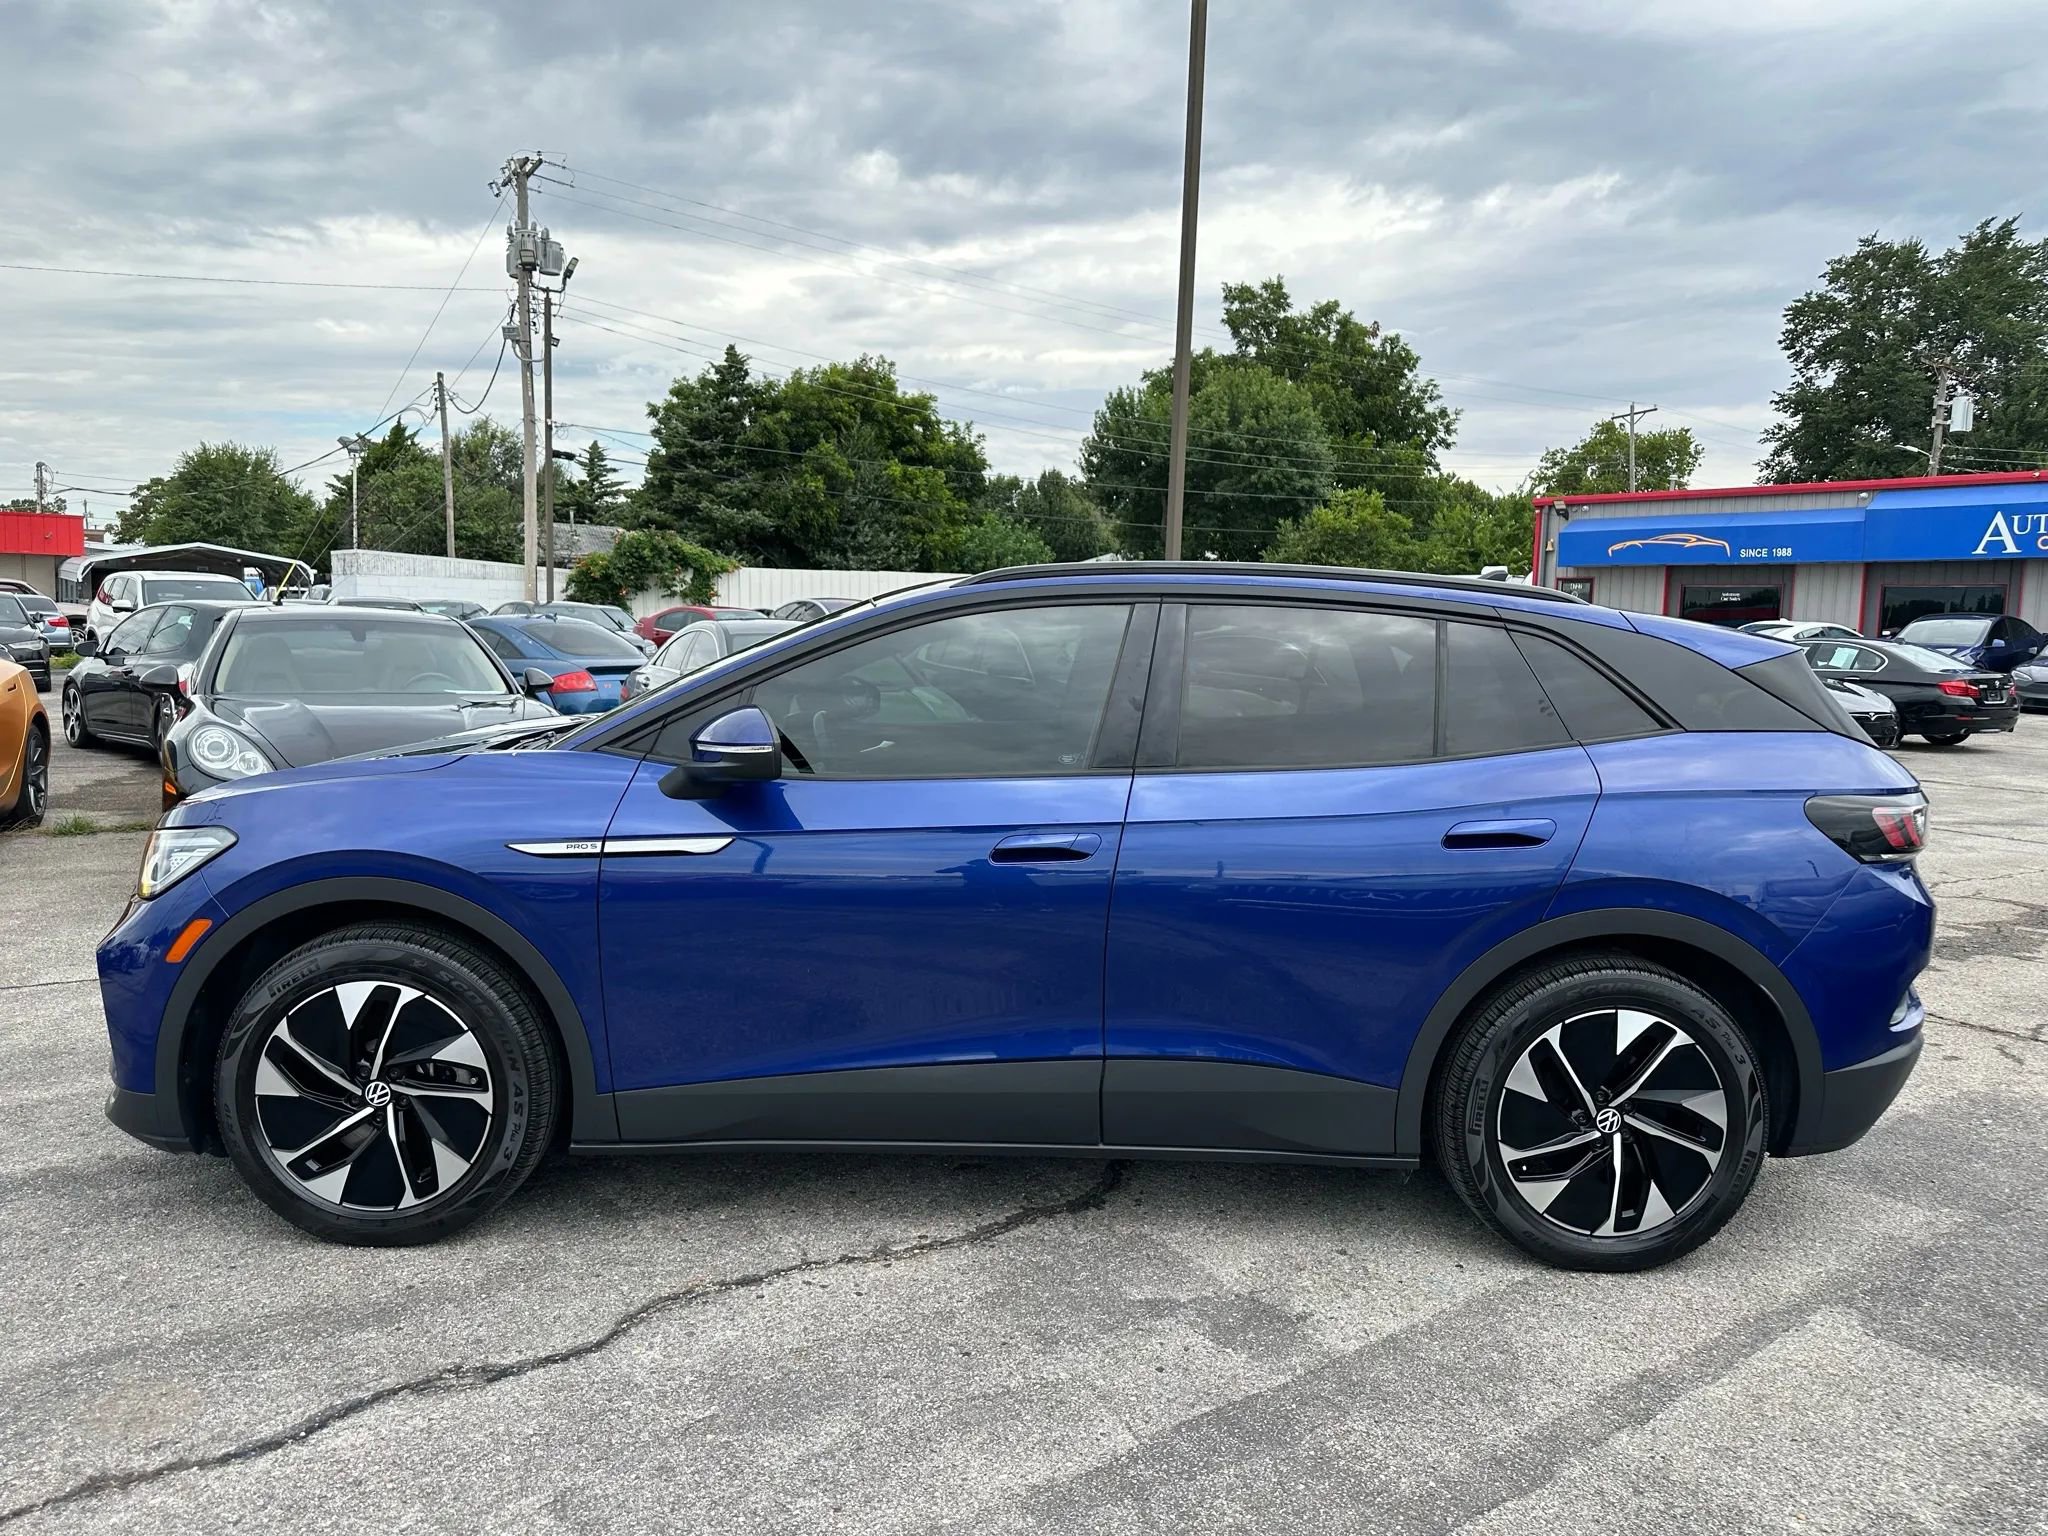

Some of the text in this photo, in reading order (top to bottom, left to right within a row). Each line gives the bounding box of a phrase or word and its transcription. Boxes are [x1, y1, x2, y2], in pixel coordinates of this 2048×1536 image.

[1740, 547, 1792, 558] SINCE 1988
[512, 1081, 524, 1118] AS
[1467, 1077, 1489, 1136] PIRELLI
